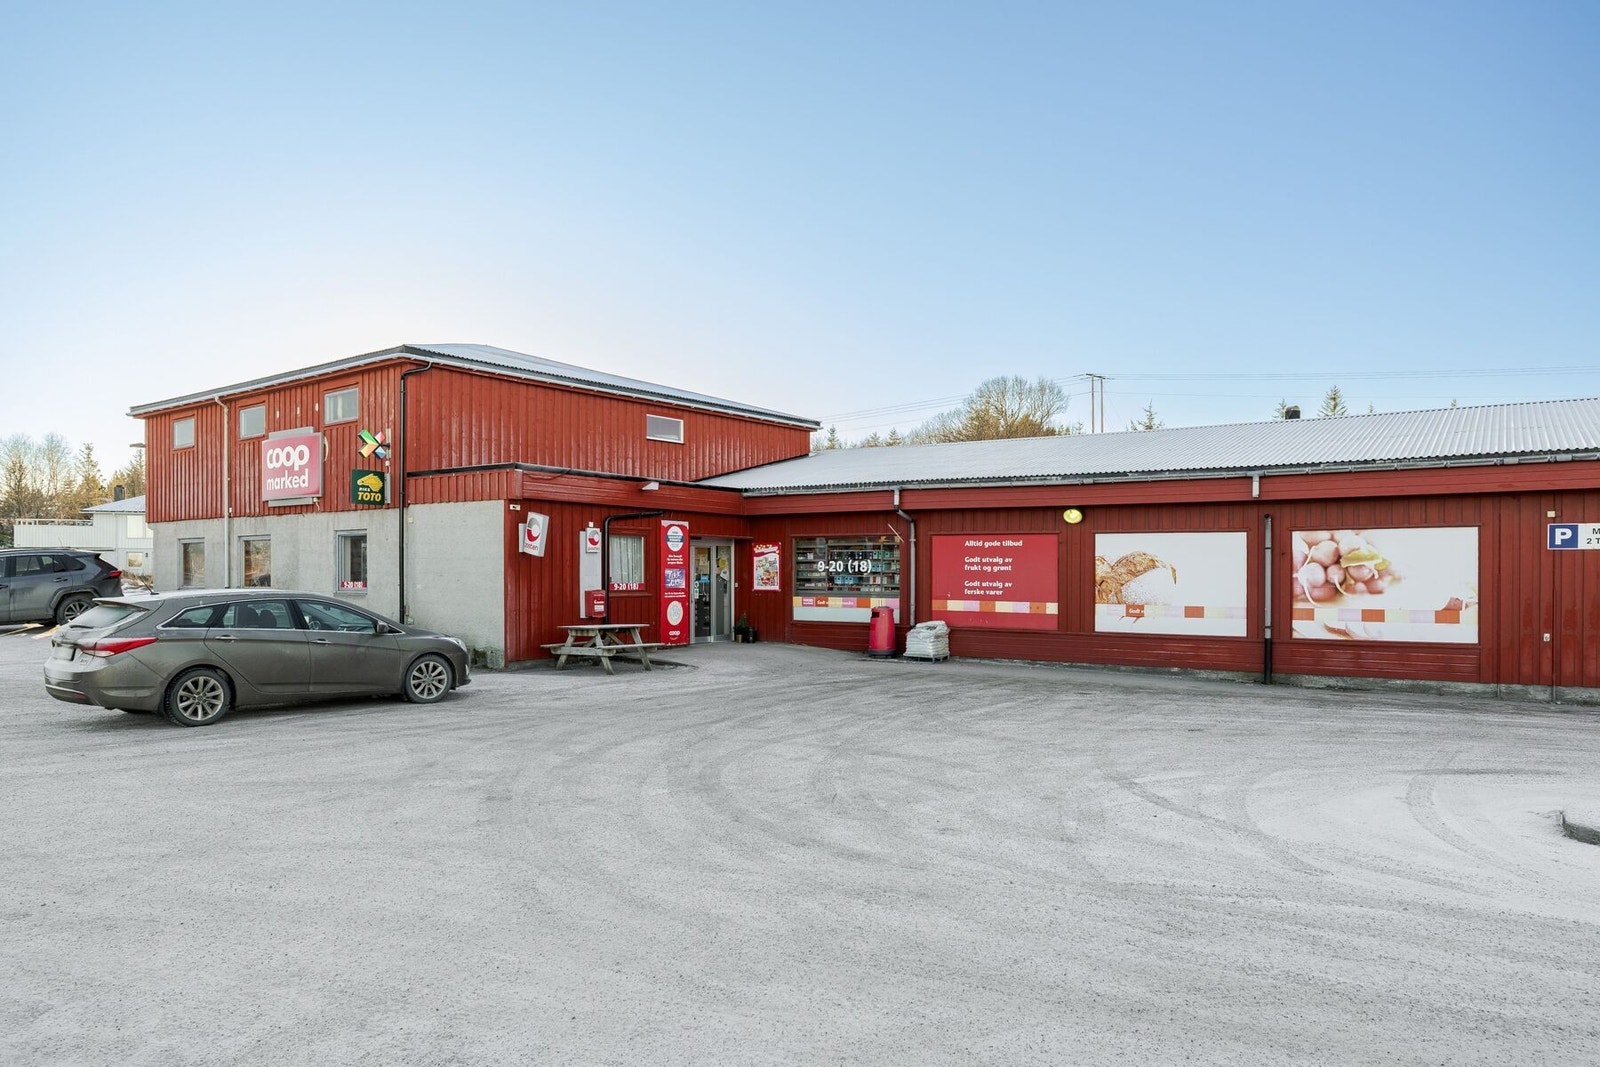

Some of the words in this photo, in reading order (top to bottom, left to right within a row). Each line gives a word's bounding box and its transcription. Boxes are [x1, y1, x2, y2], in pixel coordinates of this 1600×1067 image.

[266, 444, 310, 471] coop
[266, 468, 309, 491] marked
[357, 491, 382, 502] TOTO
[1555, 528, 1573, 545] P
[1586, 537, 1592, 545] 2
[984, 540, 1001, 548] gode
[817, 560, 844, 572] 9-20
[847, 559, 872, 573] (18)
[982, 556, 1003, 564] utvalg
